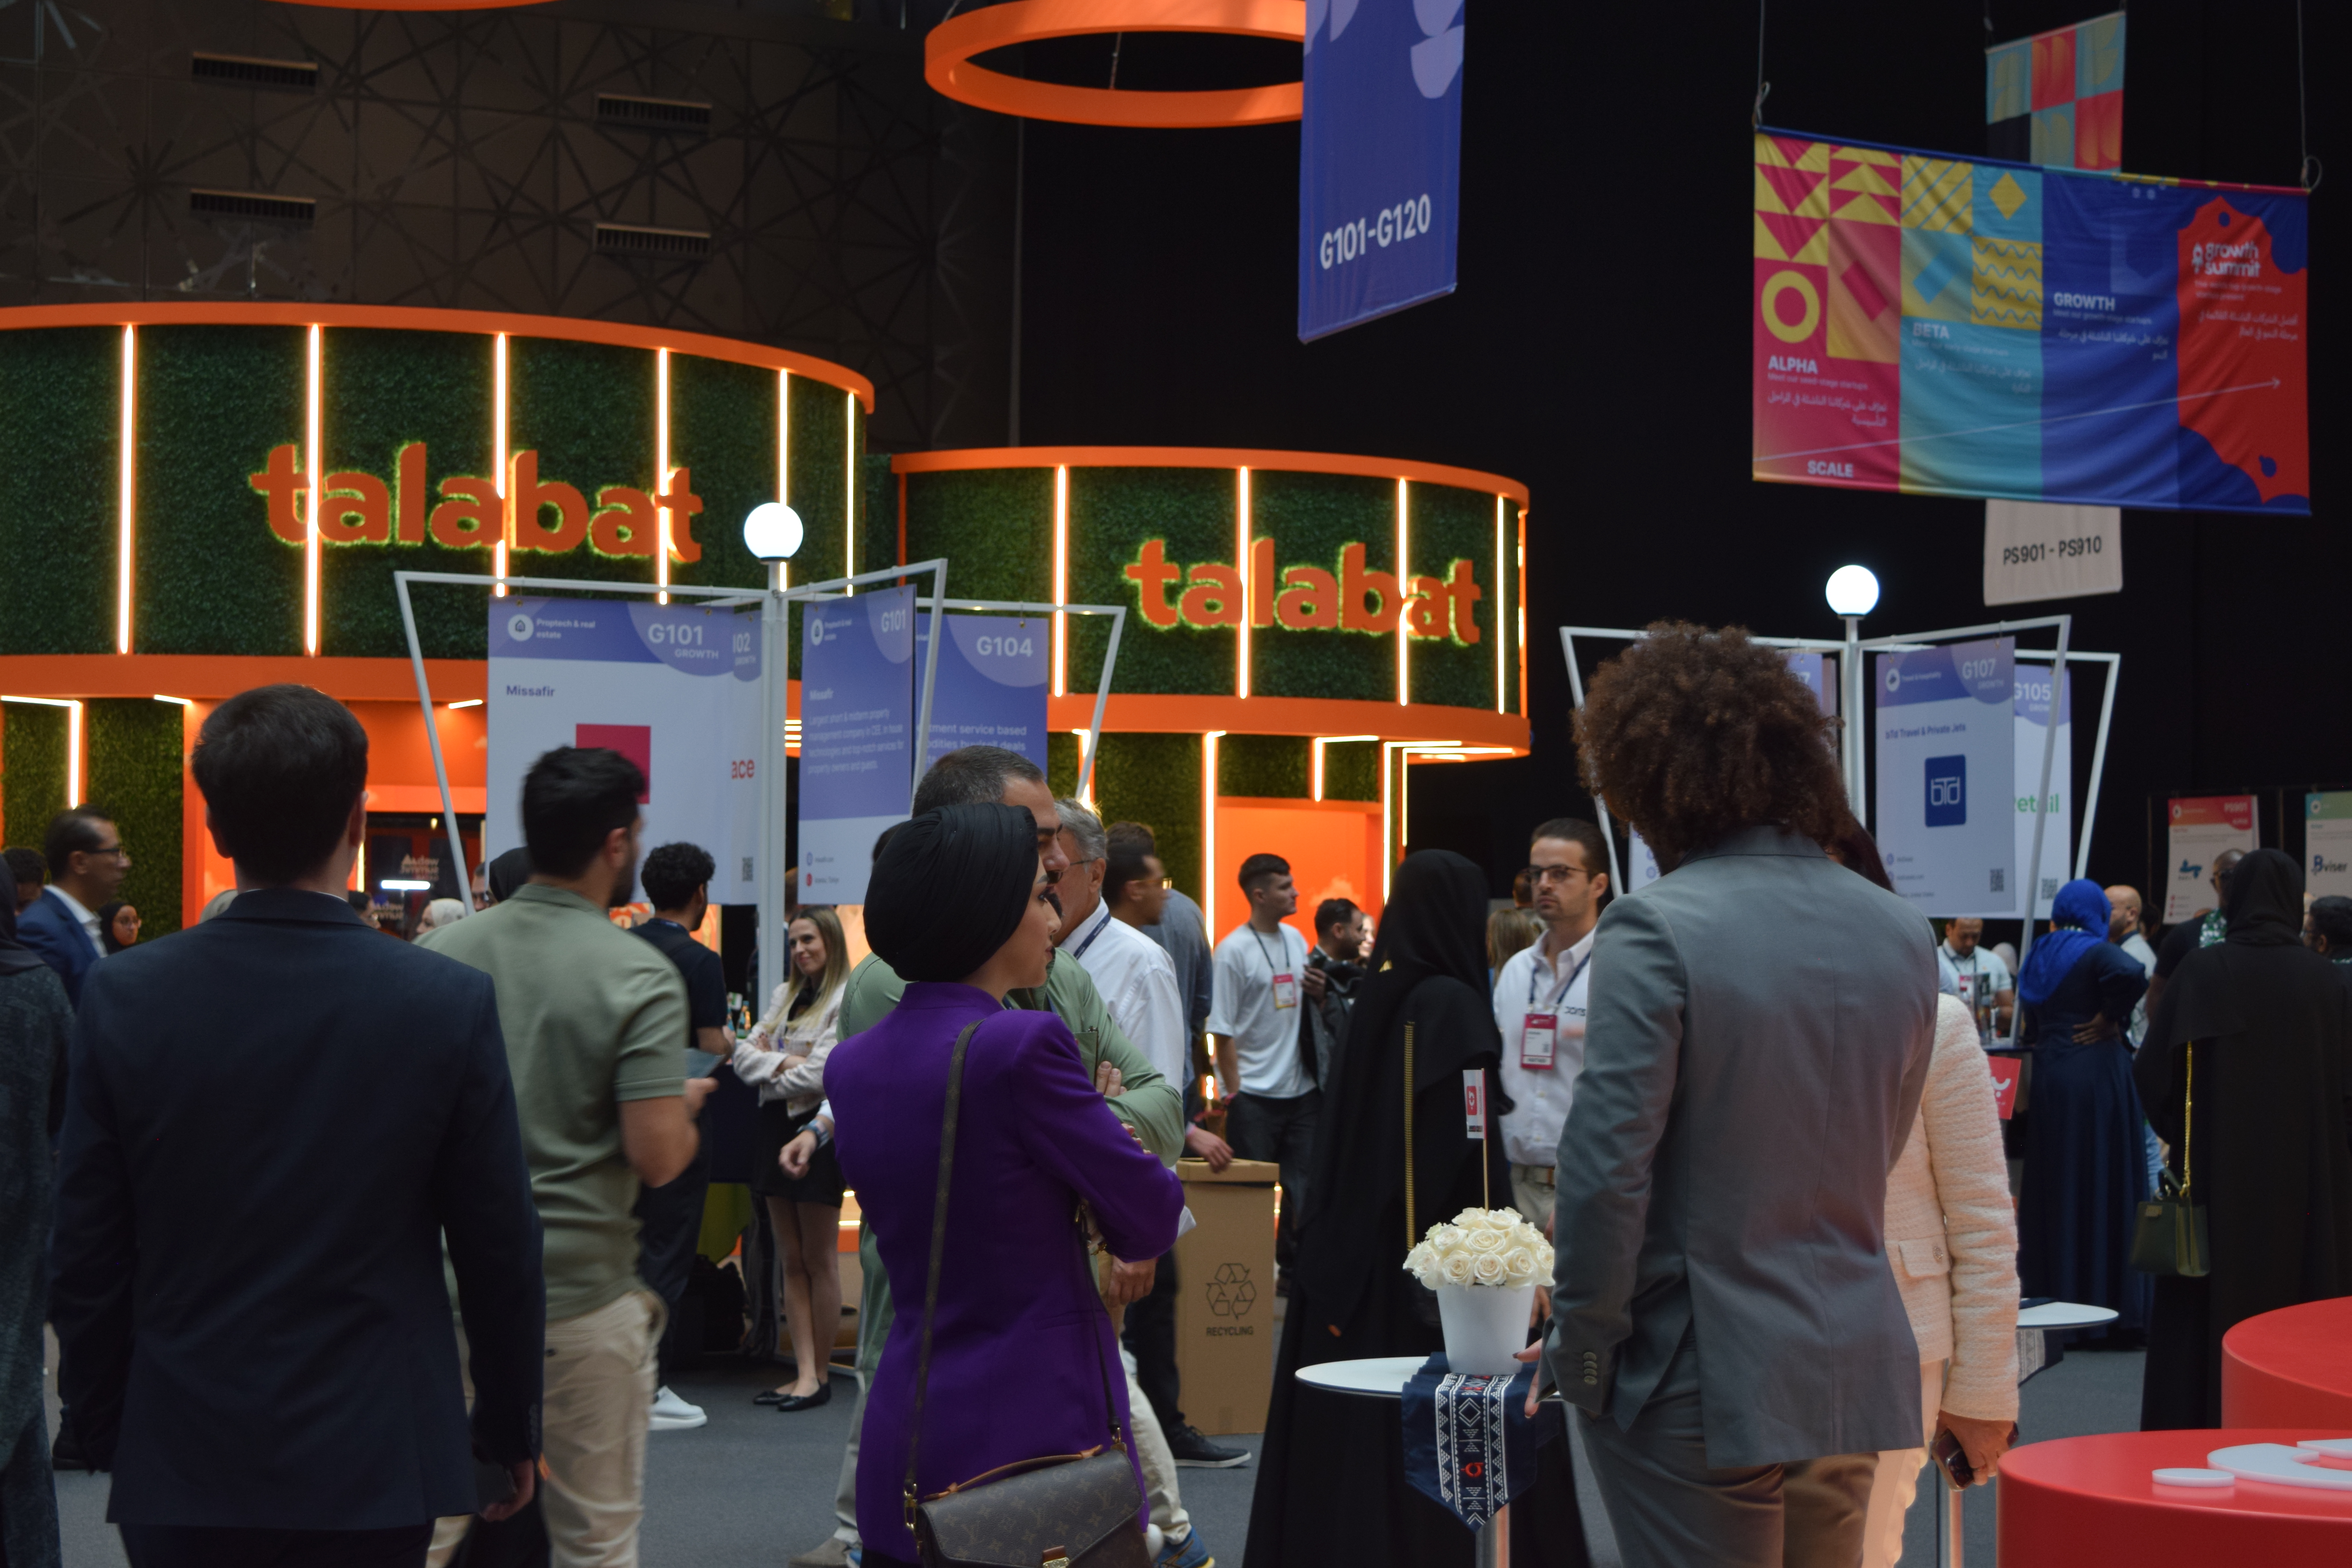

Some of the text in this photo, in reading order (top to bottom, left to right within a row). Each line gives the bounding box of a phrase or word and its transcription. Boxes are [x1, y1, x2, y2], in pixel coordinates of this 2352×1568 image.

[1319, 193, 1431, 270] G101-G120
[2205, 241, 2259, 261] growth
[2205, 260, 2261, 278] summit
[2054, 292, 2116, 311] GROWTH
[1913, 322, 1951, 339] BETA
[1768, 355, 1818, 375] ALPHA
[1808, 460, 1853, 477] SCALE
[248, 442, 704, 563] talabat
[2003, 543, 2045, 565] PS901
[2059, 535, 2102, 557] PS910
[1124, 538, 1481, 646] talabat
[881, 609, 906, 633] G101
[648, 623, 703, 646] G101
[733, 632, 751, 653] 102
[675, 648, 719, 660] GROWTH
[976, 636, 1033, 657] G104
[1962, 658, 1996, 679] G107
[506, 684, 555, 697] Missafir
[2014, 682, 2051, 701] G105
[960, 724, 995, 735] service
[997, 725, 1027, 736] based
[1900, 726, 1920, 738] Travel
[1921, 726, 1926, 736] &
[1927, 724, 1950, 735] Private
[731, 759, 755, 780] ace
[2014, 793, 2059, 813] etil
[1206, 1325, 1254, 1336] RECYCLING
